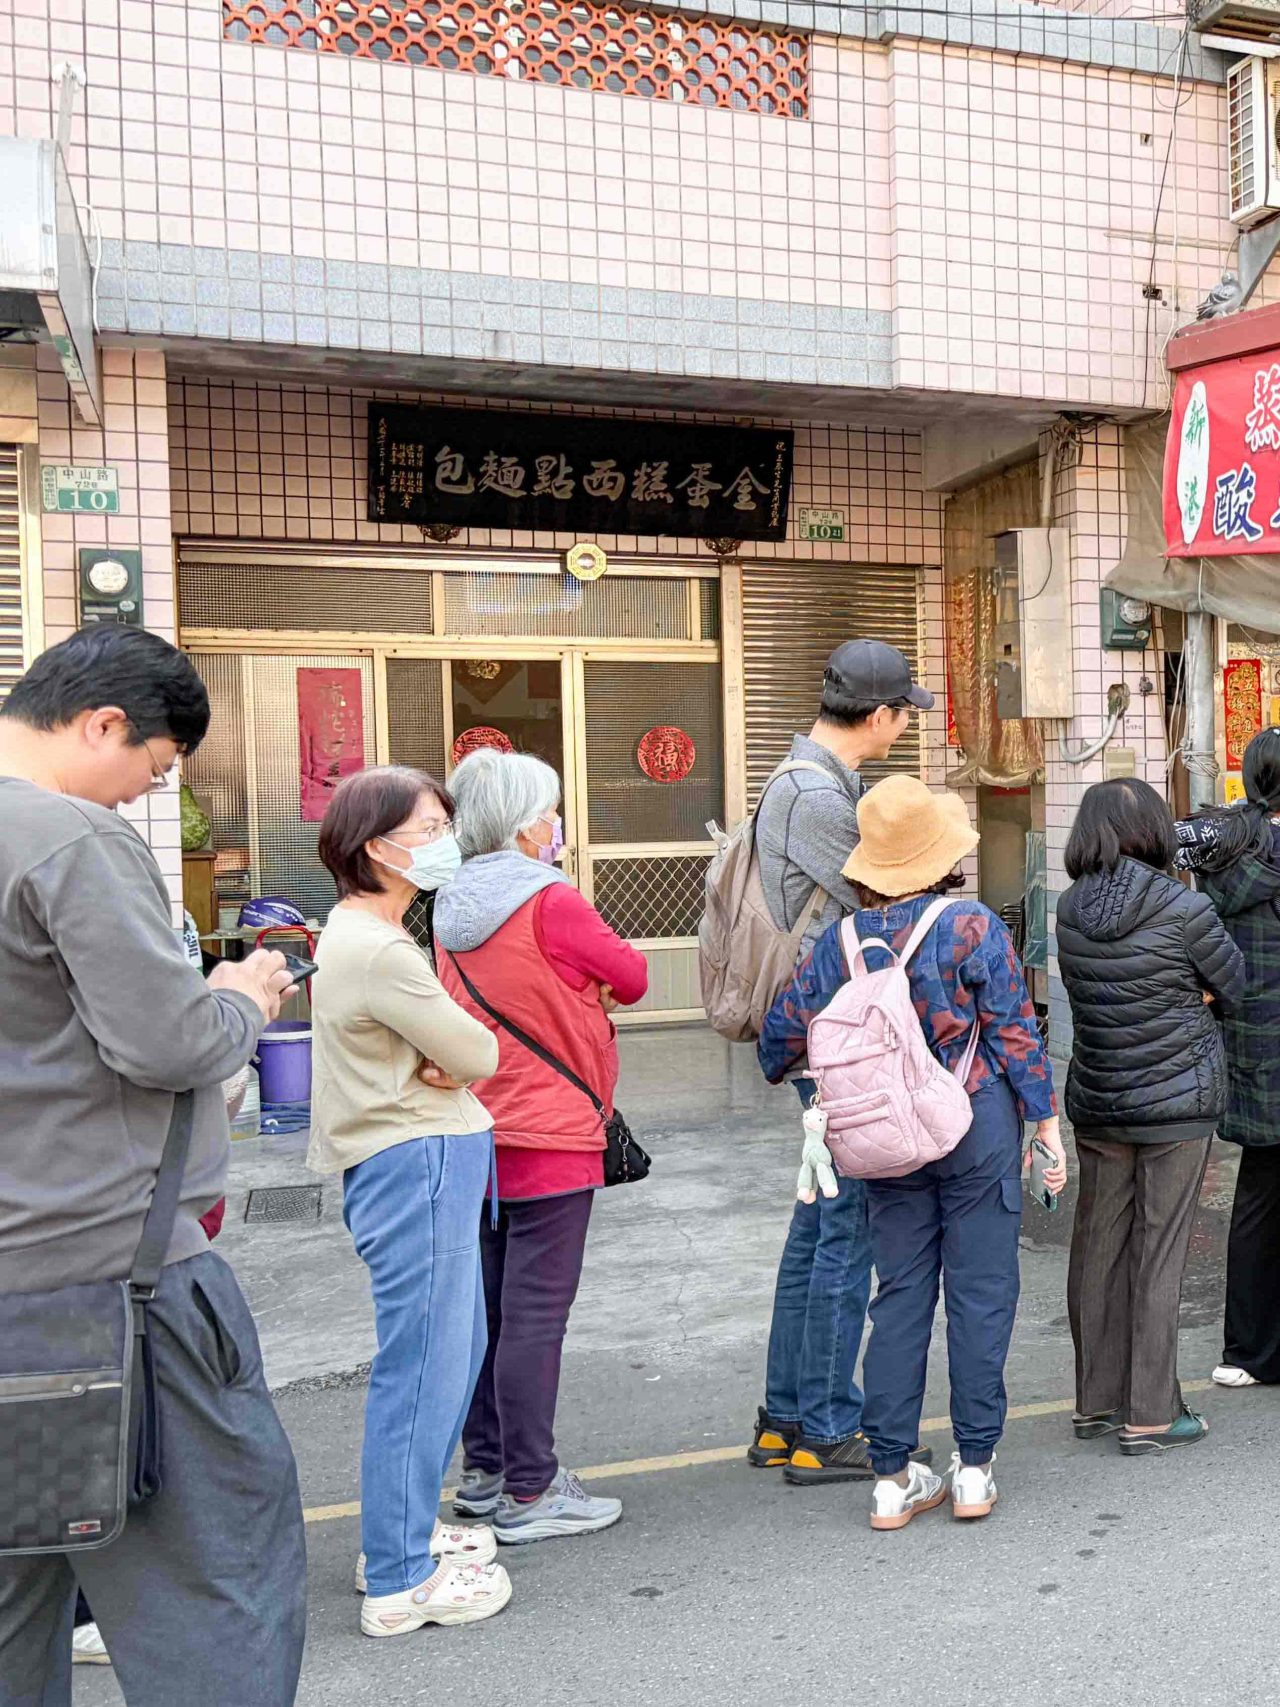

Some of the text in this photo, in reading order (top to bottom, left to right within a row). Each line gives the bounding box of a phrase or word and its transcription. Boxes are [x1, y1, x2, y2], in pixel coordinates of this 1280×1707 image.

[1184, 402, 1206, 524] 新港
[62, 467, 109, 481] 中山路
[70, 490, 108, 510] 10
[811, 511, 839, 520] 中山路
[811, 525, 831, 539] 10
[654, 742, 679, 772] 福
